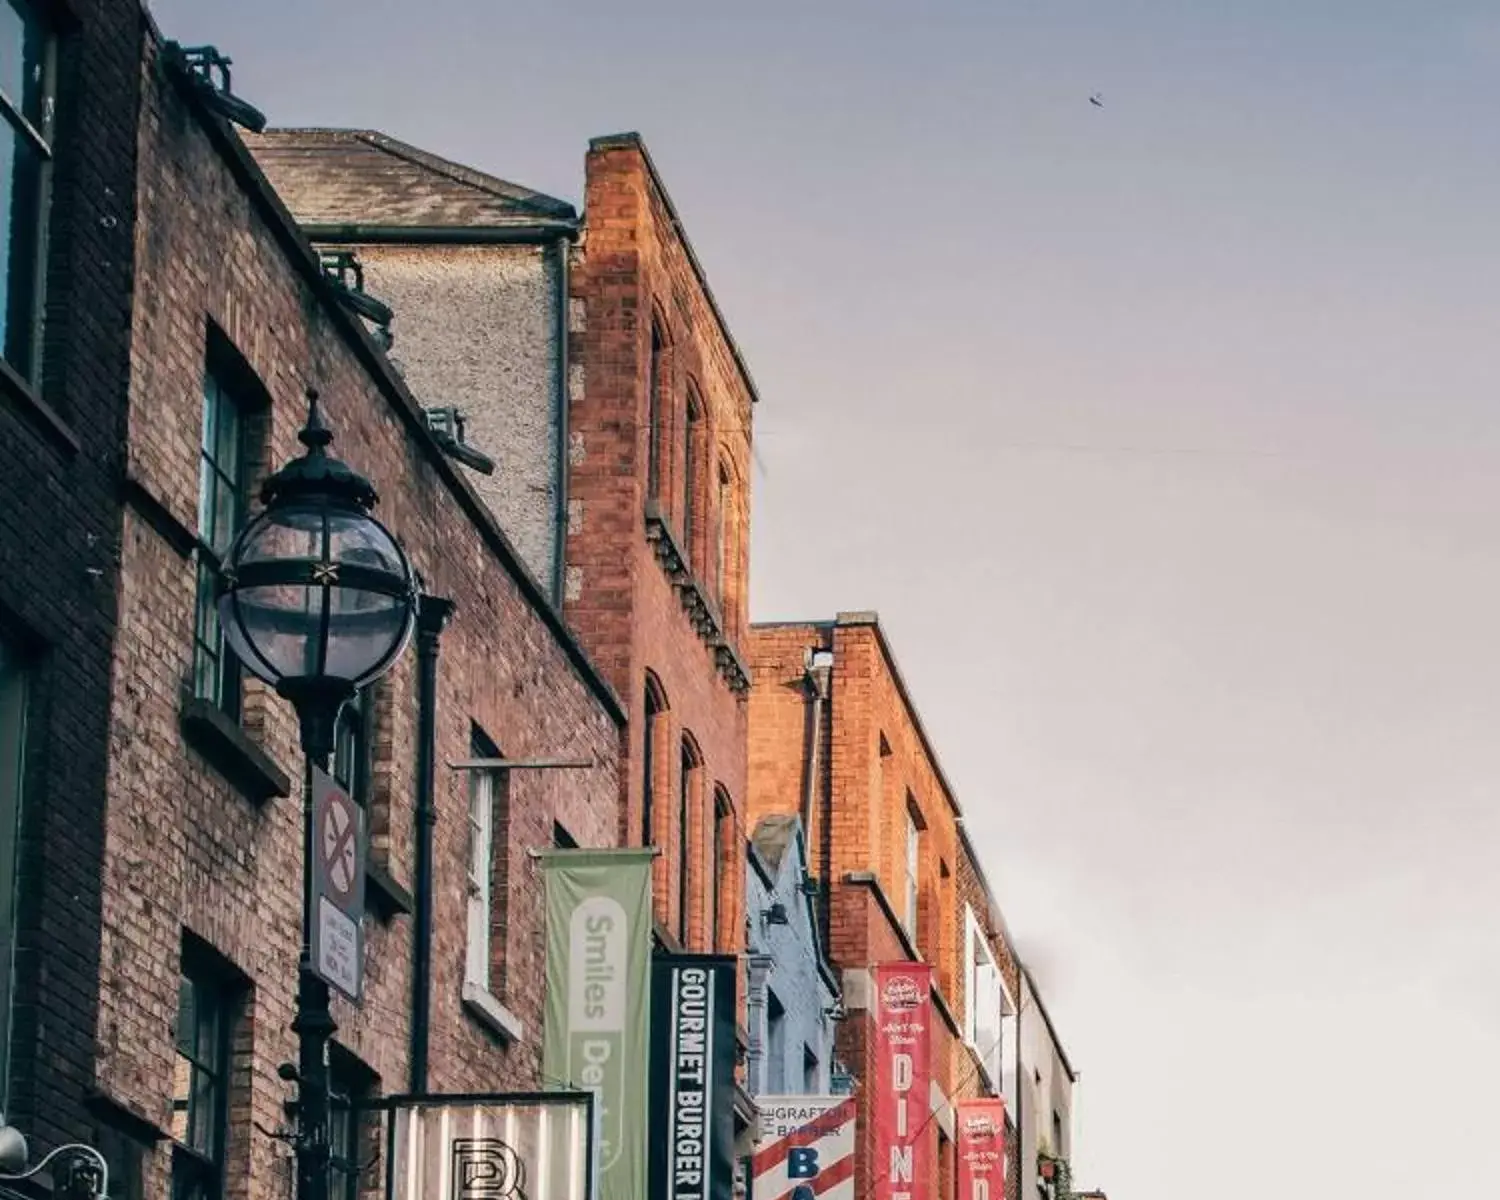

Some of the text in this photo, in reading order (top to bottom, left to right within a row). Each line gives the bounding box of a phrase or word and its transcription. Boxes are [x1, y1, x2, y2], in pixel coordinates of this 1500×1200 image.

[584, 914, 615, 1021] Smiles
[678, 968, 706, 1085] GOURMET
[675, 1091, 703, 1186] BURGER
